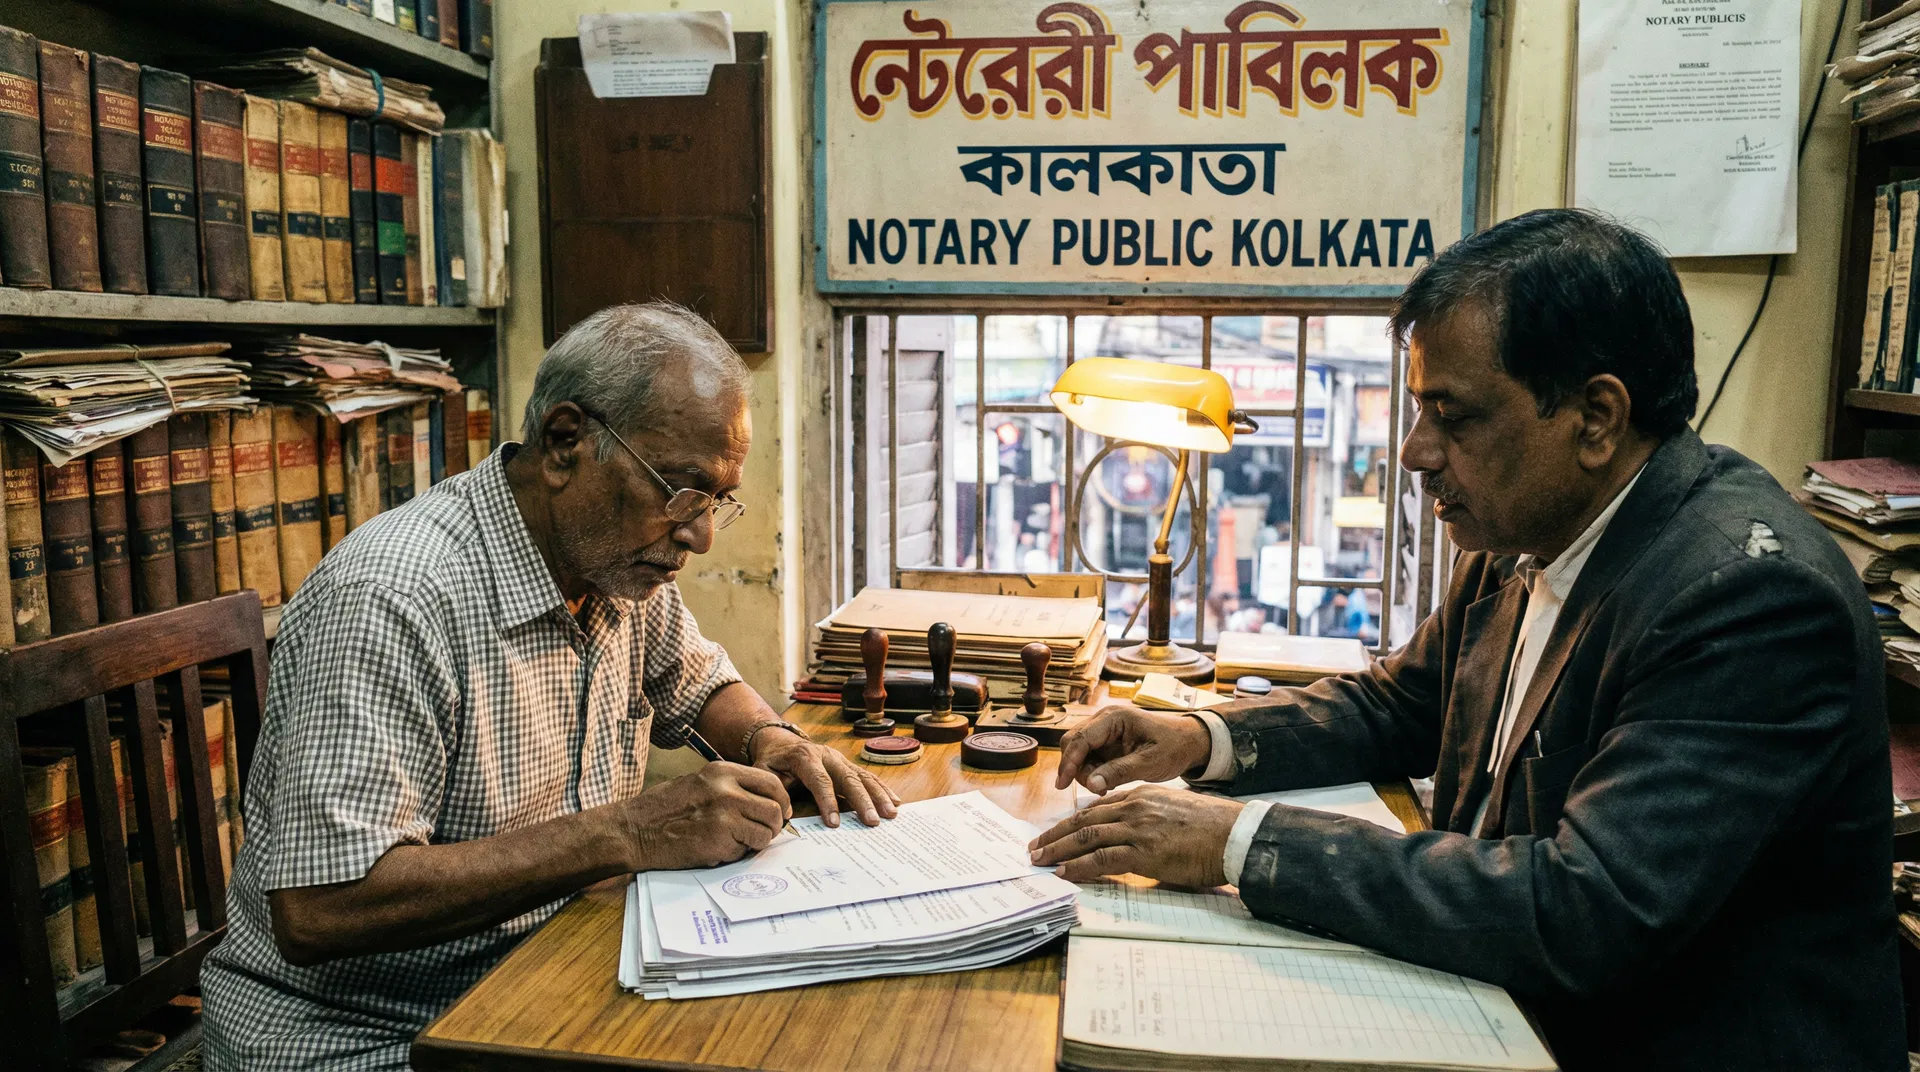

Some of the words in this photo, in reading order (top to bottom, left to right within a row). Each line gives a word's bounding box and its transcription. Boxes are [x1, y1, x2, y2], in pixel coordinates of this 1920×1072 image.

[1646, 16, 1691, 26] NOTARY
[1695, 13, 1746, 24] PUBLICIS
[957, 143, 1287, 196] কালকাতা
[848, 218, 1031, 266] NOTARY
[1052, 218, 1213, 267] PUBLIC
[1231, 218, 1435, 268] KOLKATA
